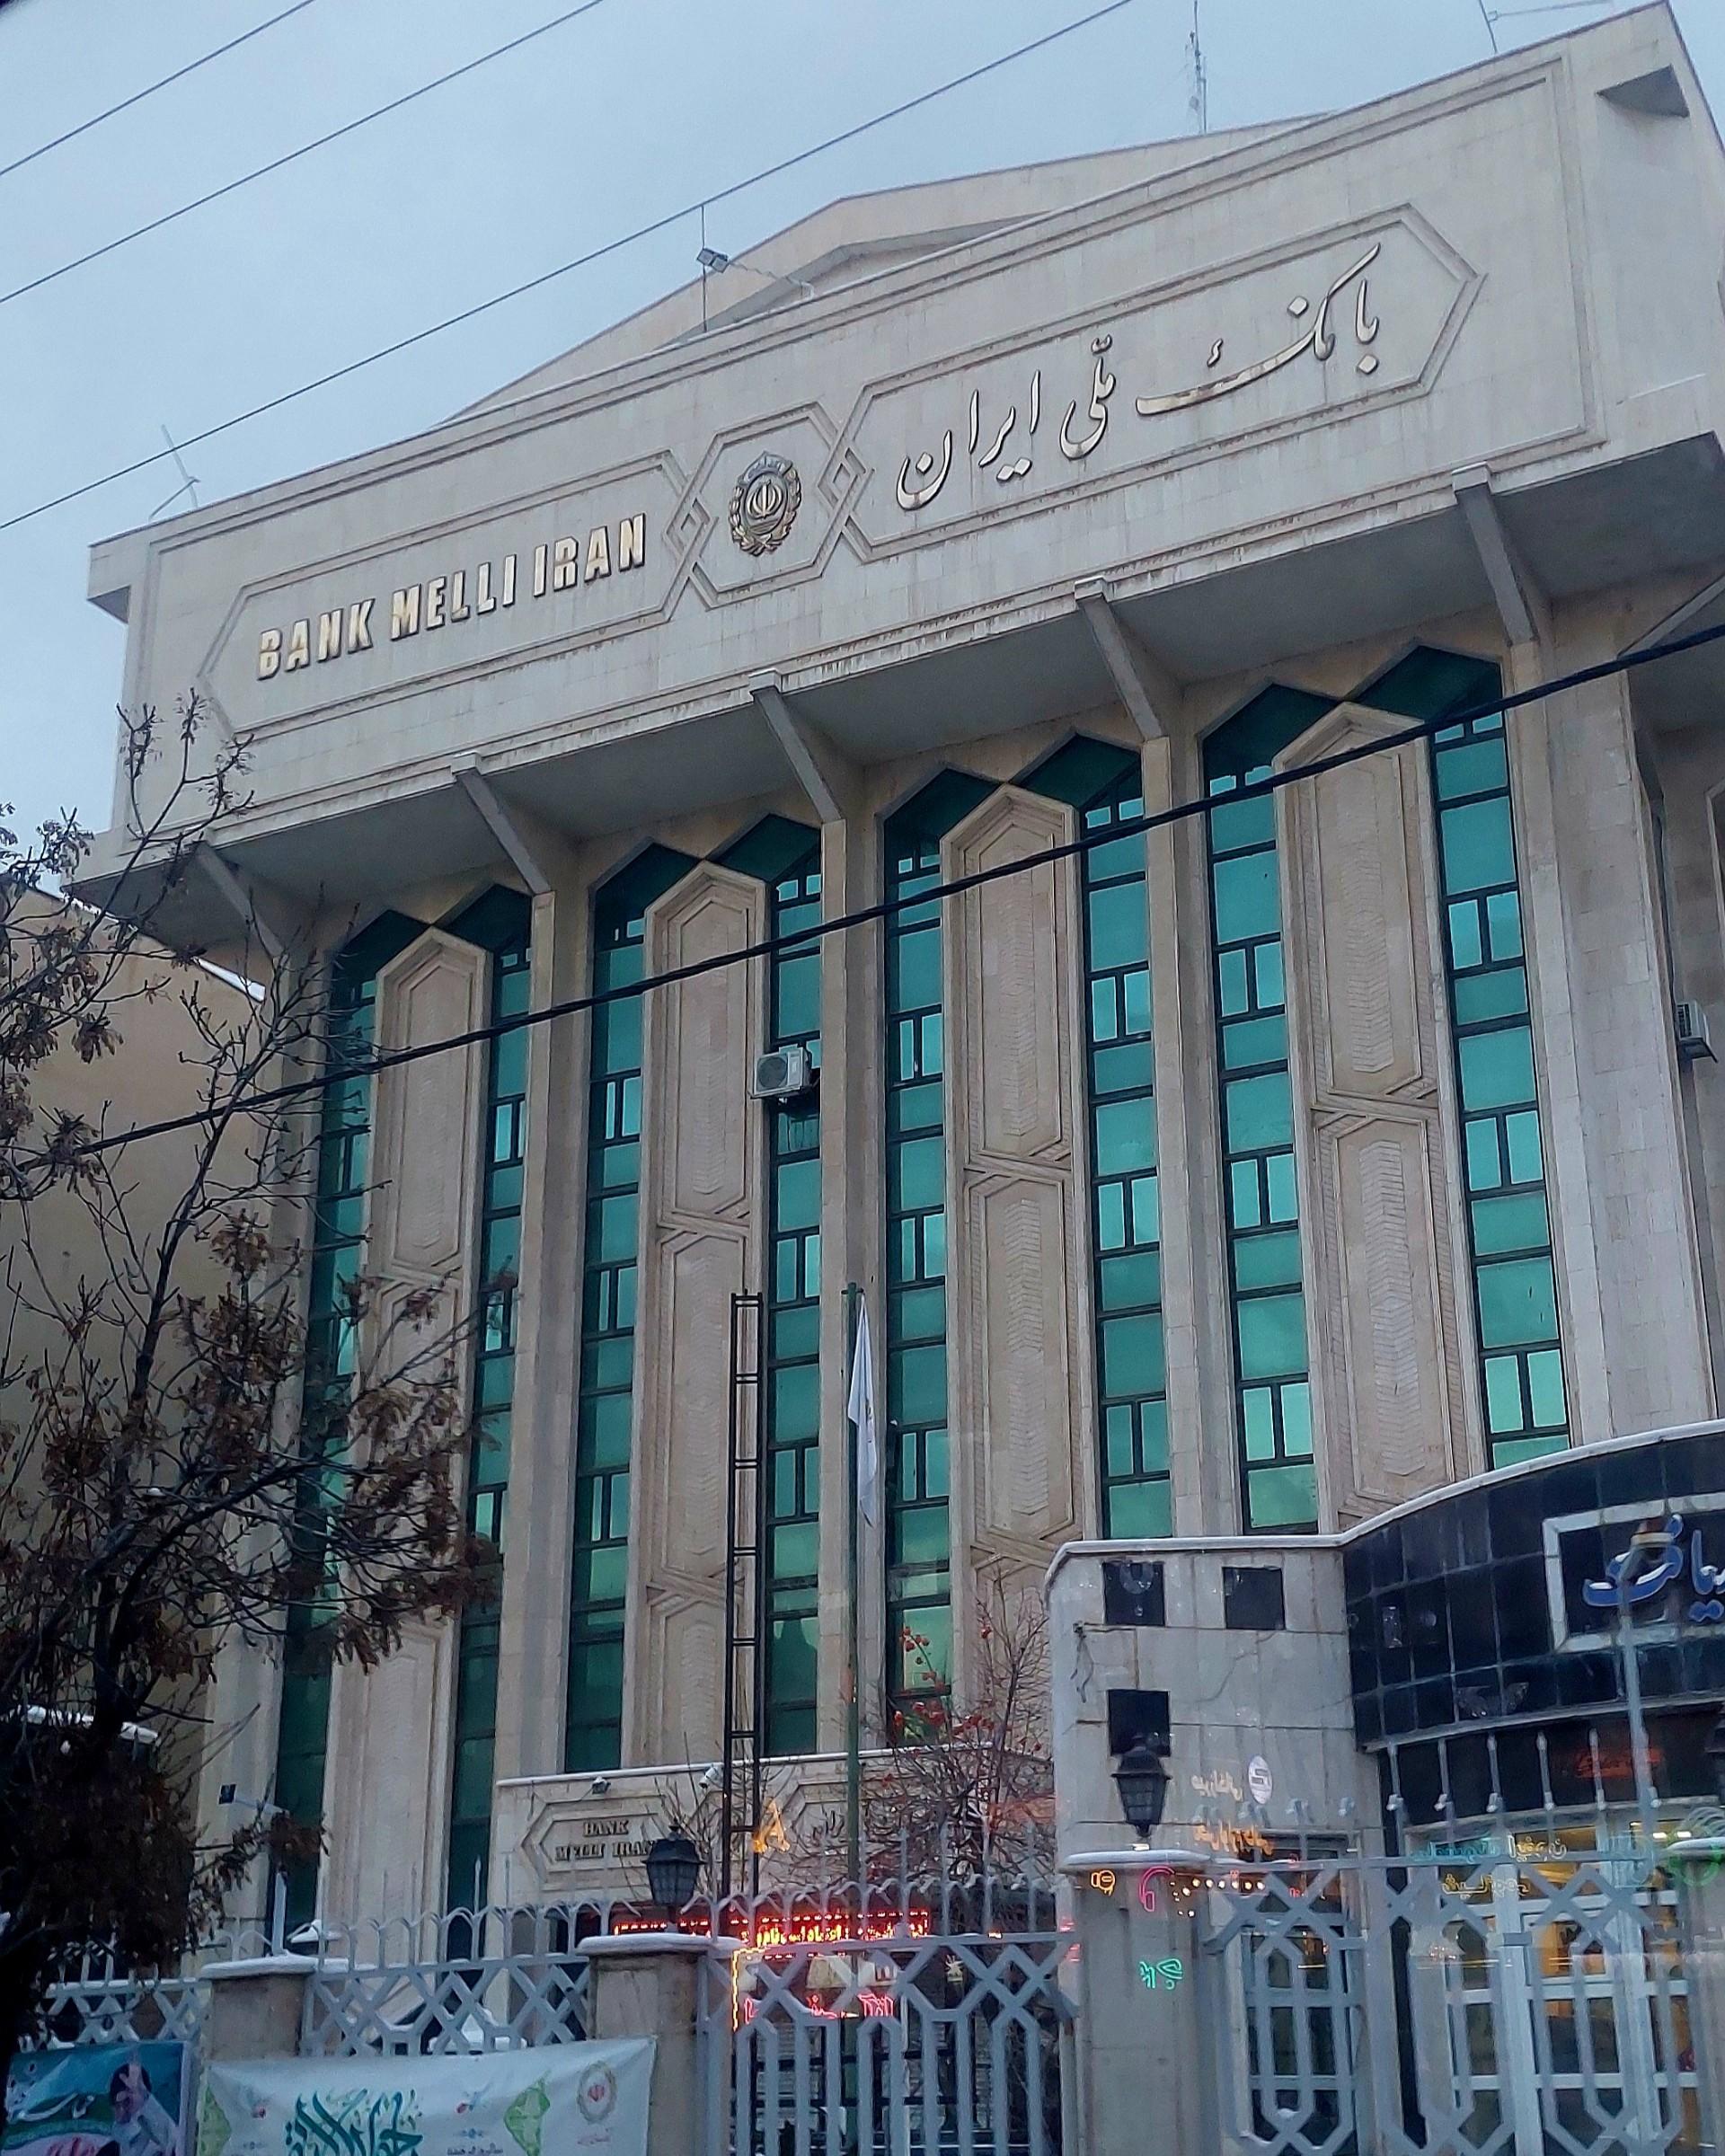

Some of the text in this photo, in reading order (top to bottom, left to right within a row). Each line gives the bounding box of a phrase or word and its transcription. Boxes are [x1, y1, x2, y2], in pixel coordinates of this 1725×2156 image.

[1136, 243, 1381, 415] بانک
[896, 369, 1041, 511] ایران
[257, 513, 646, 680] BANK MELLI IRAN
[555, 1842, 606, 1861] MELLI
[584, 1819, 630, 1837] BANK
